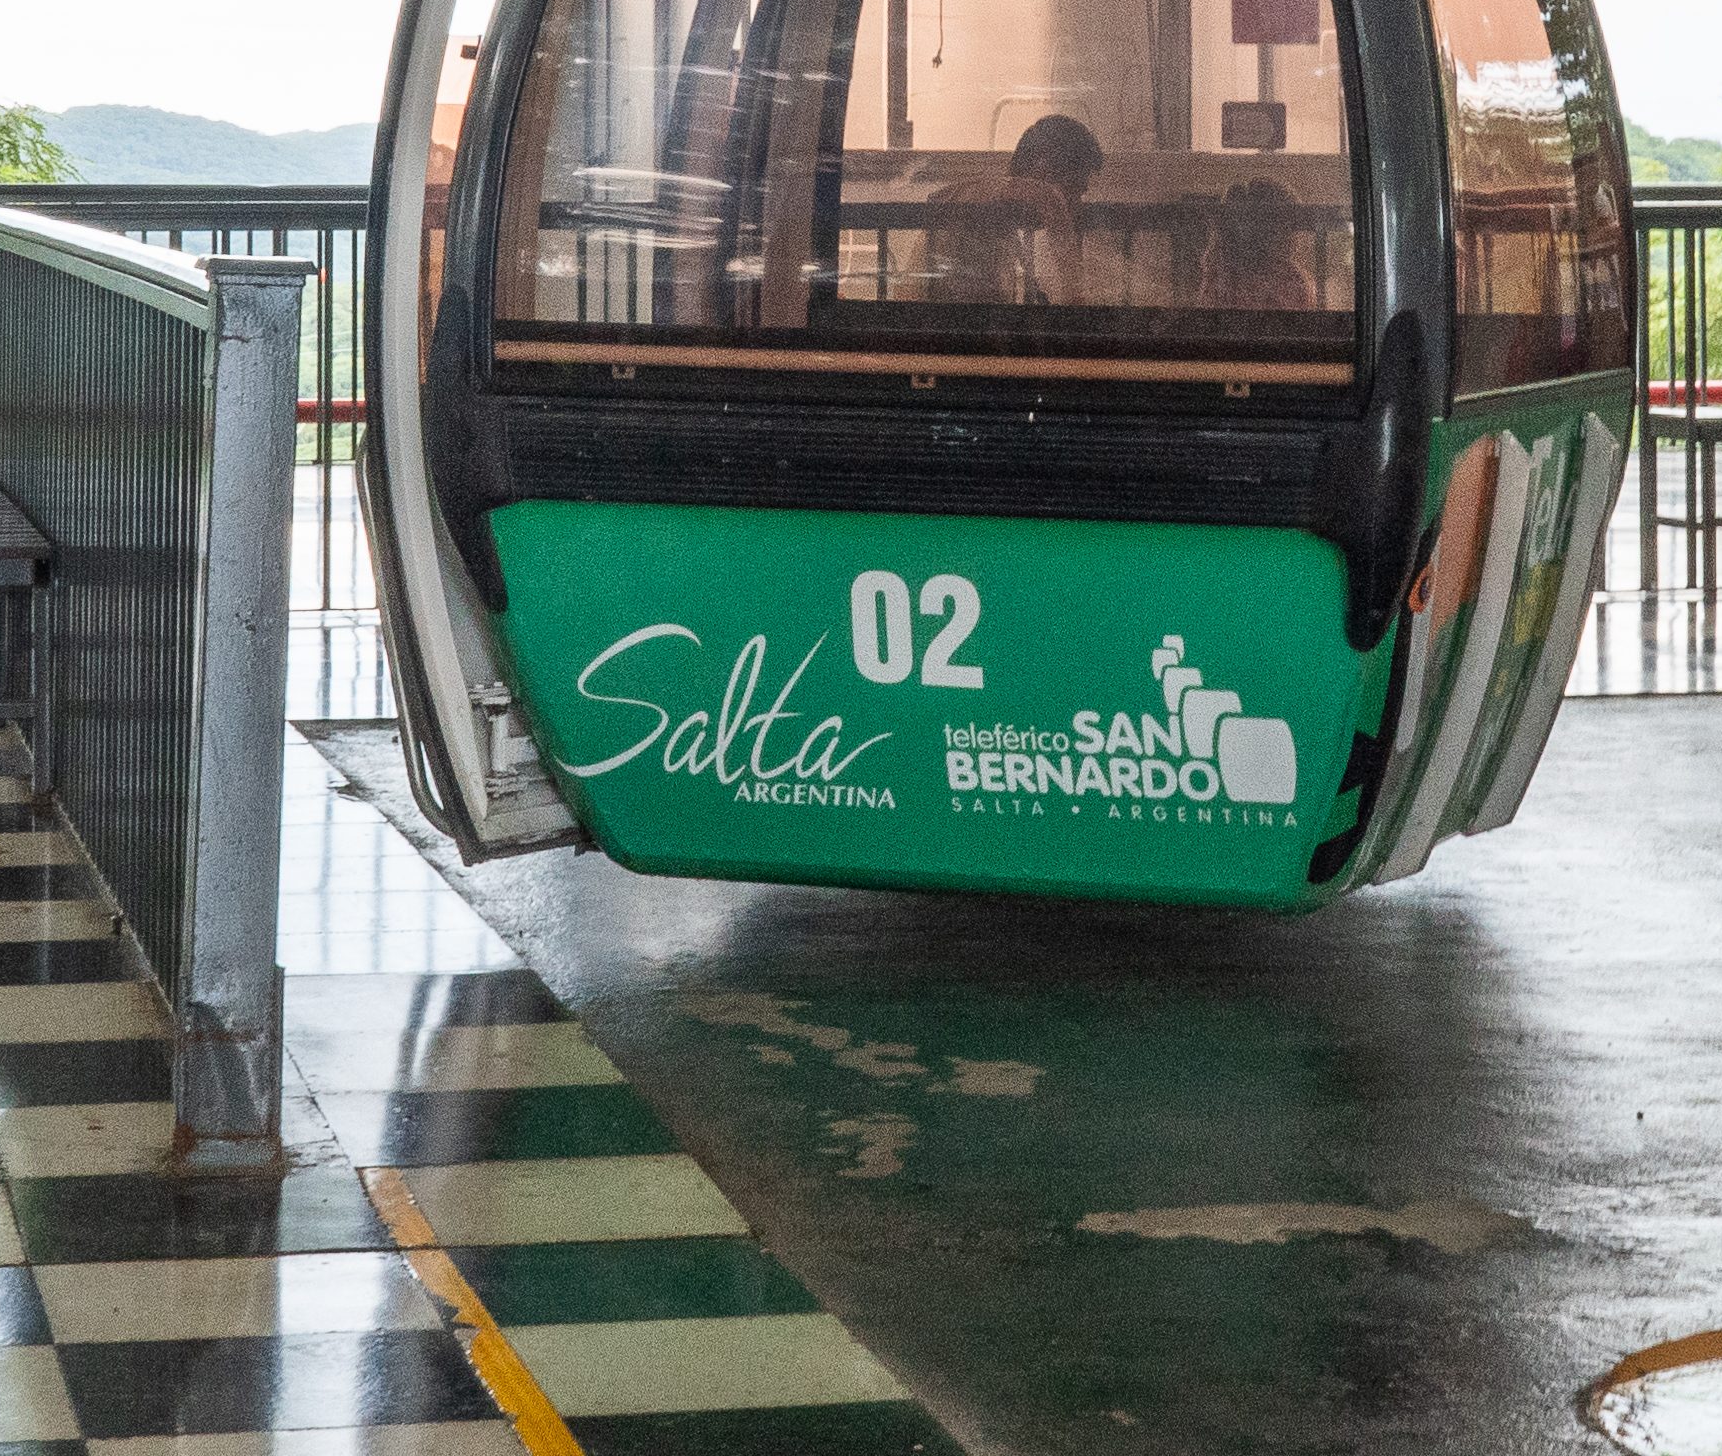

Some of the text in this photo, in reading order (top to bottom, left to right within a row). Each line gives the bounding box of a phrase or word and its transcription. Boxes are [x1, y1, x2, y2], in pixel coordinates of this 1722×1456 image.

[850, 569, 984, 690] 02
[554, 622, 893, 784] Salta
[943, 710, 1183, 757] teleférico SAN
[734, 780, 897, 810] ARGENTINA
[945, 750, 1220, 802] BERNARDO
[950, 797, 1298, 827] SALTA ARGENTINA
